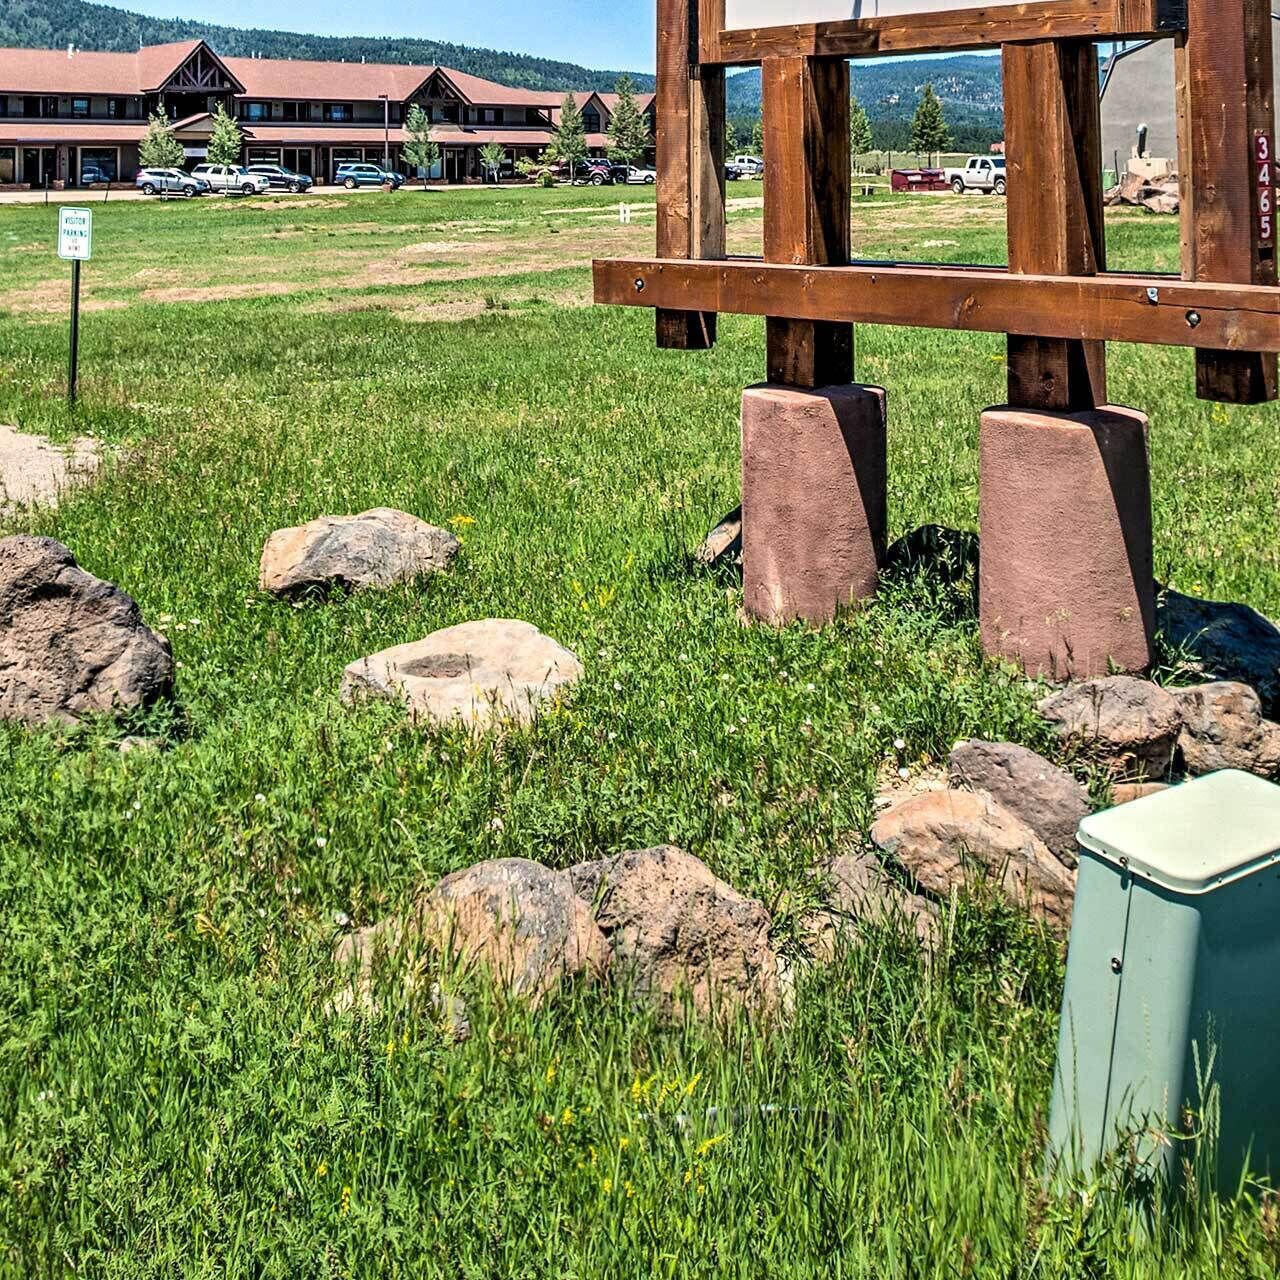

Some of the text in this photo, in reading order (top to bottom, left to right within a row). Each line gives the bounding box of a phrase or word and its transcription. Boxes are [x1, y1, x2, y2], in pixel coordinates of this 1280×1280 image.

[1258, 136, 1271, 239] 3465
[64, 217, 86, 225] VISITOR
[63, 228, 88, 238] PARKING
